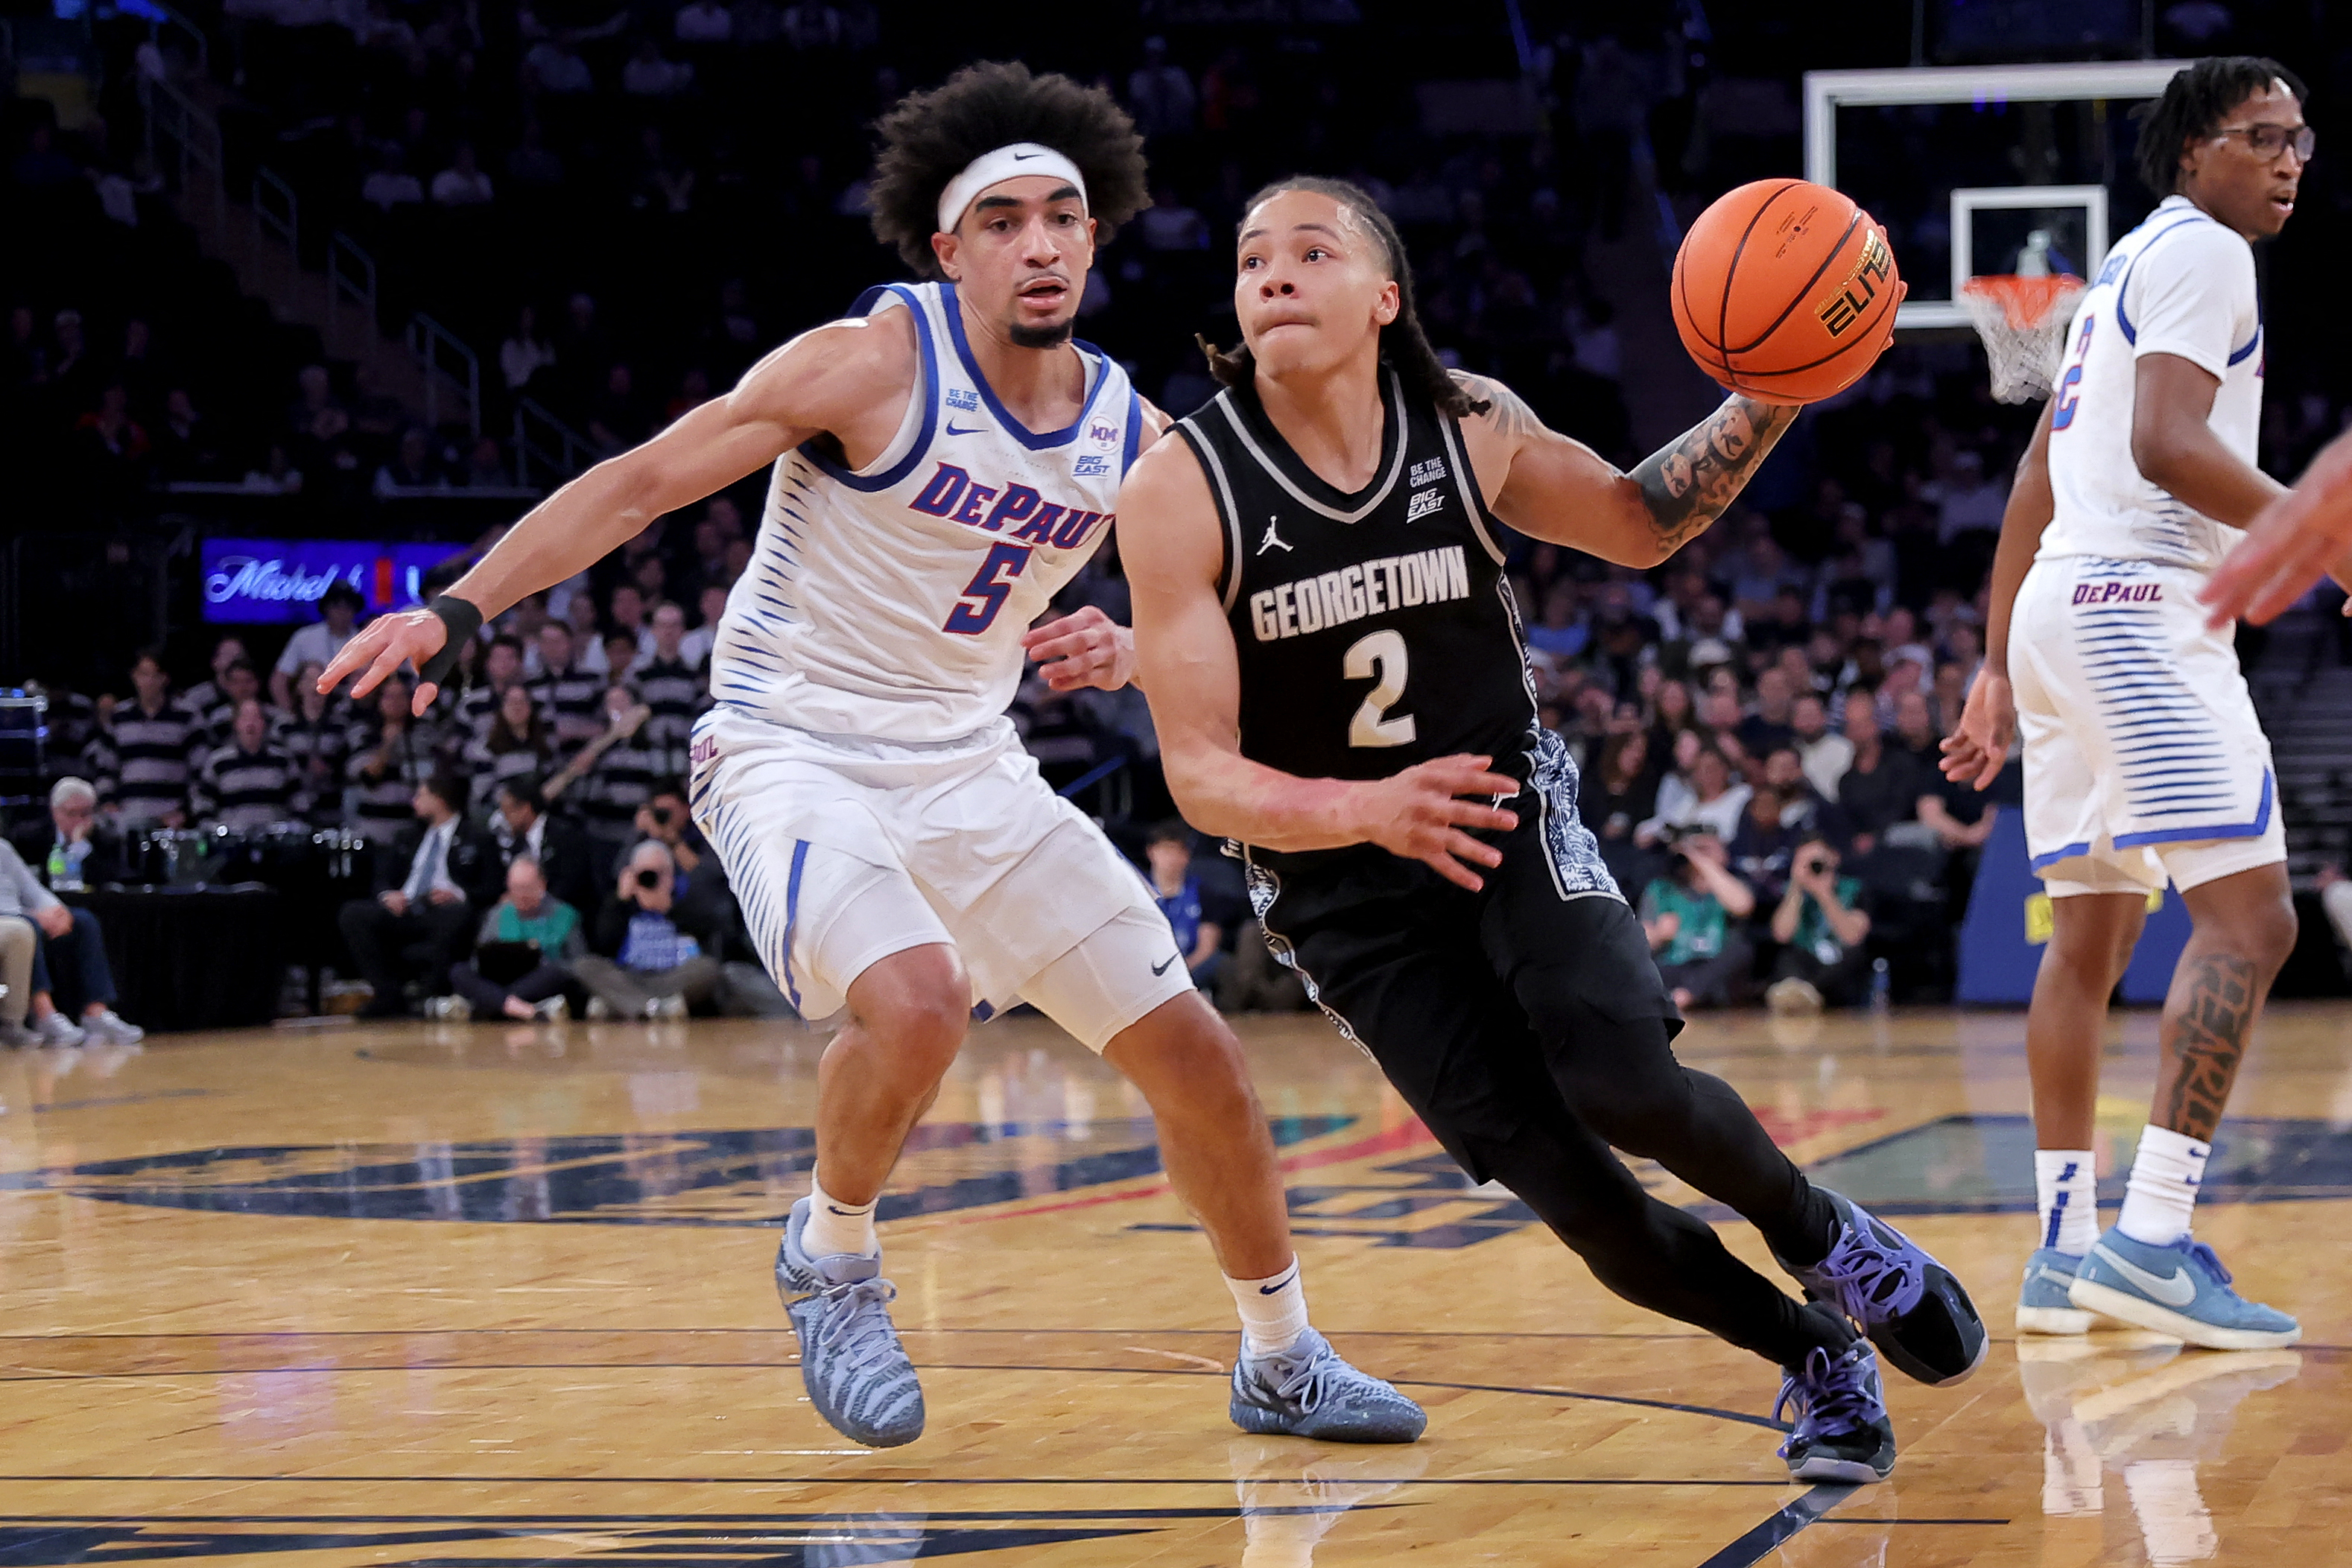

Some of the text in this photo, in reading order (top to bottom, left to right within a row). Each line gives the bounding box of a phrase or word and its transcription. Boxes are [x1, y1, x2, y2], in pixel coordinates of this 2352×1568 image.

[1074, 465, 1111, 474] EAST
[1077, 455, 1103, 465] BIG
[1410, 457, 1442, 477] BE THE
[1410, 467, 1447, 488] CHANGE
[1407, 494, 1445, 518] EAST
[1410, 487, 1438, 507] BIG
[942, 542, 1033, 635] 5
[1249, 545, 1471, 644] GEORGETOWN
[1343, 629, 1416, 749] 2
